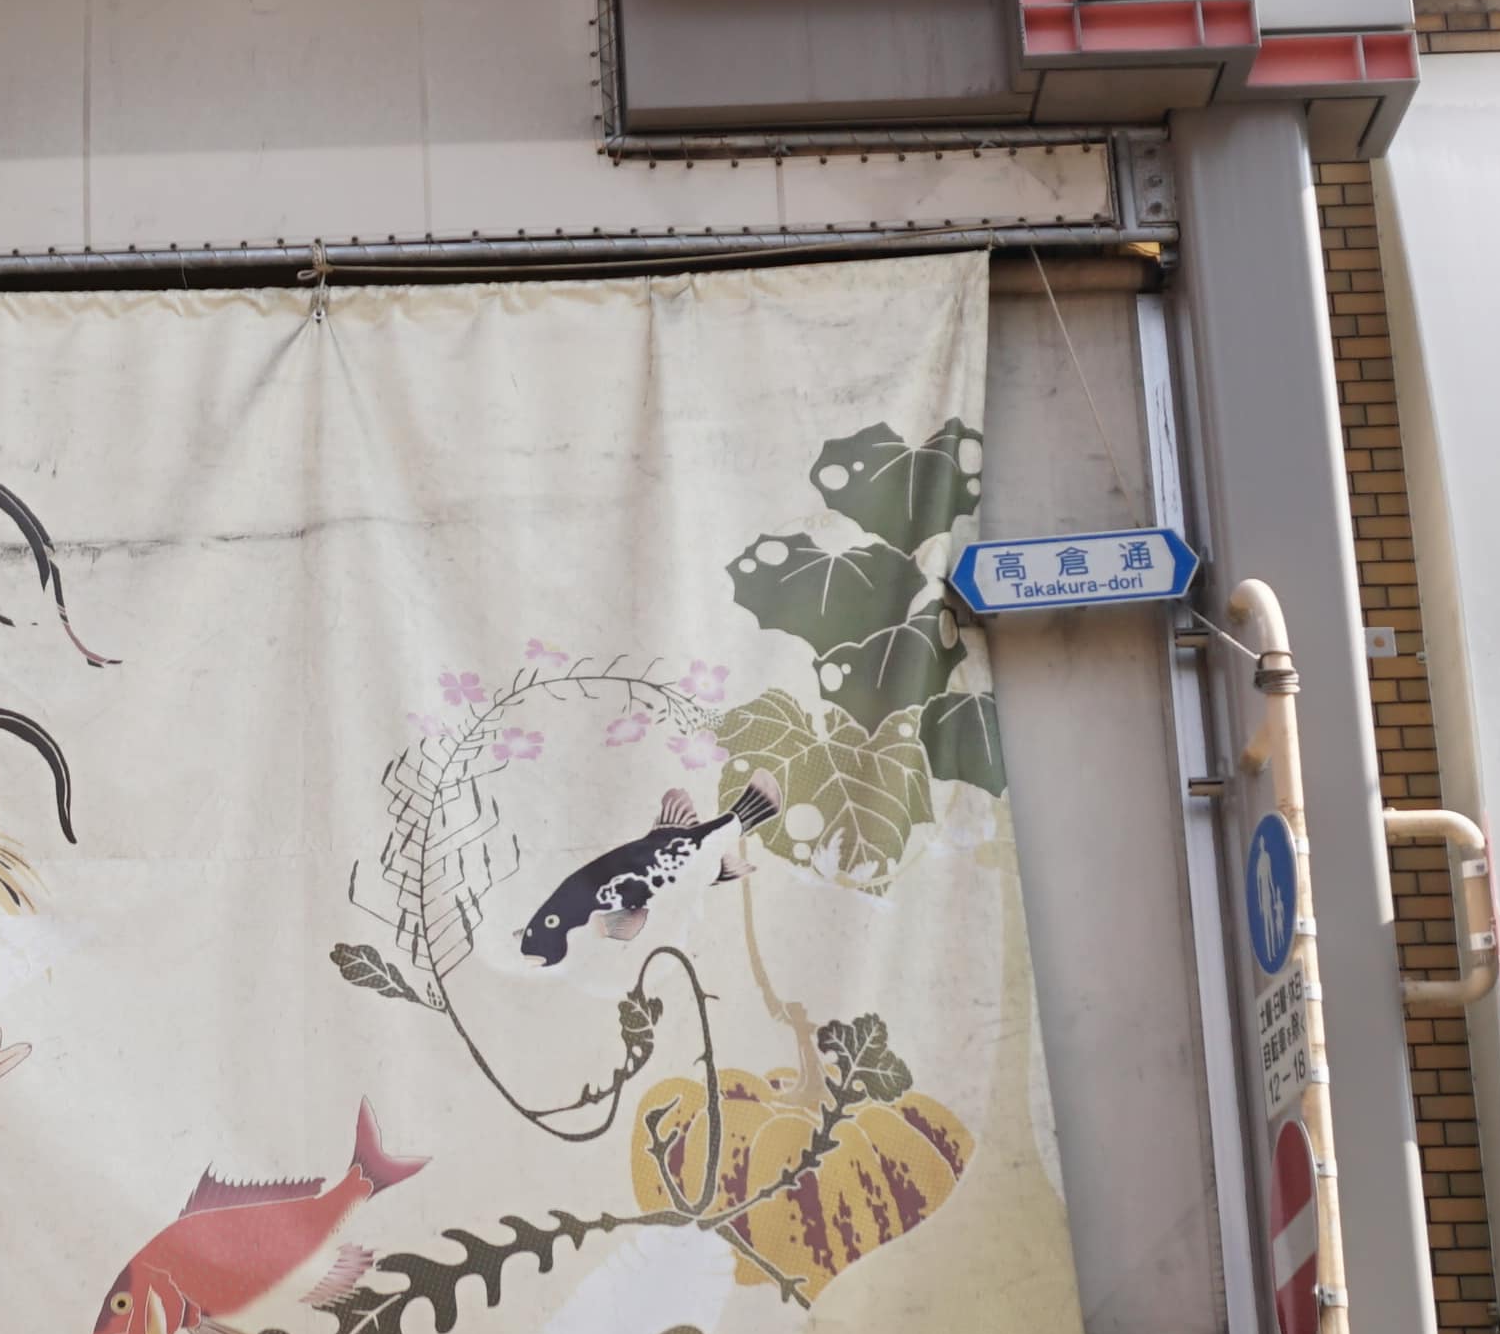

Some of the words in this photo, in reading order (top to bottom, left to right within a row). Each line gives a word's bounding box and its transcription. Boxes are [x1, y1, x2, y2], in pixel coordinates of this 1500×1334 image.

[991, 539, 1157, 584] 高倉通
[1009, 571, 1146, 600] Takakura-dori
[1262, 1009, 1307, 1071] 自転車を除く
